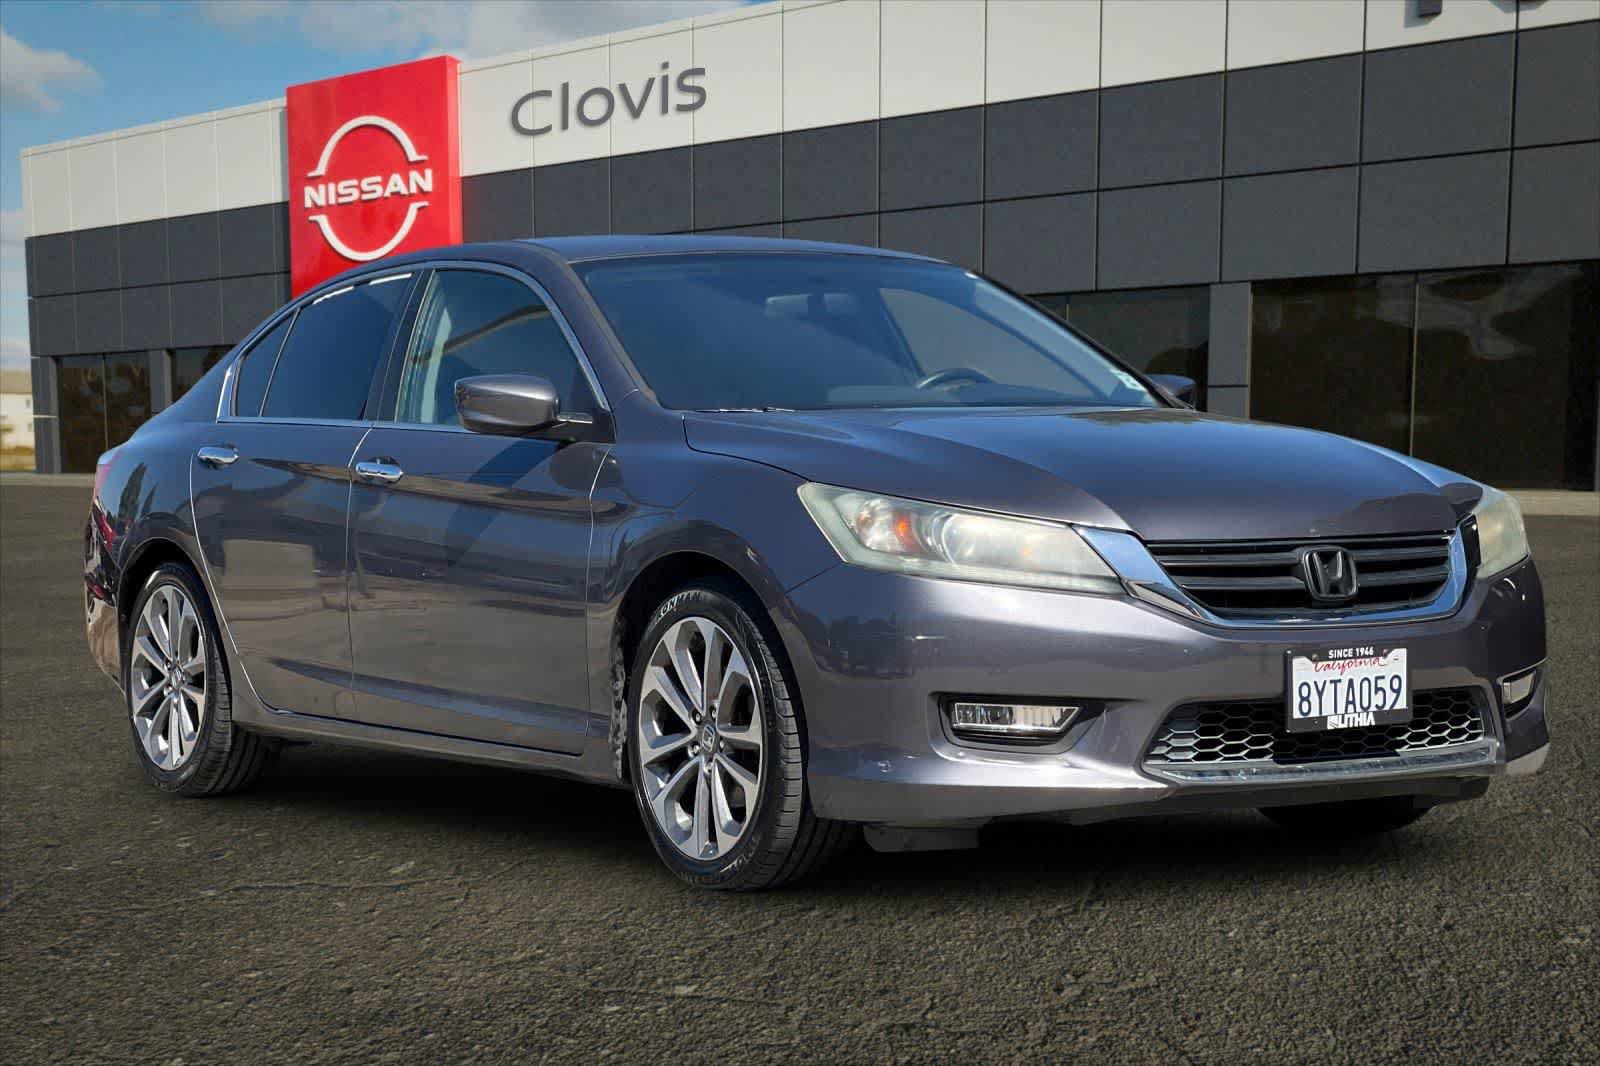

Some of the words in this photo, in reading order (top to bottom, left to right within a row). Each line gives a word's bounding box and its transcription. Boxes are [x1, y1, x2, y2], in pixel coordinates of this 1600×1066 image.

[304, 168, 433, 208] NISSAN
[1328, 648, 1353, 659] SINCE
[1355, 646, 1374, 657] 1946
[1298, 674, 1402, 717] 8YTA059
